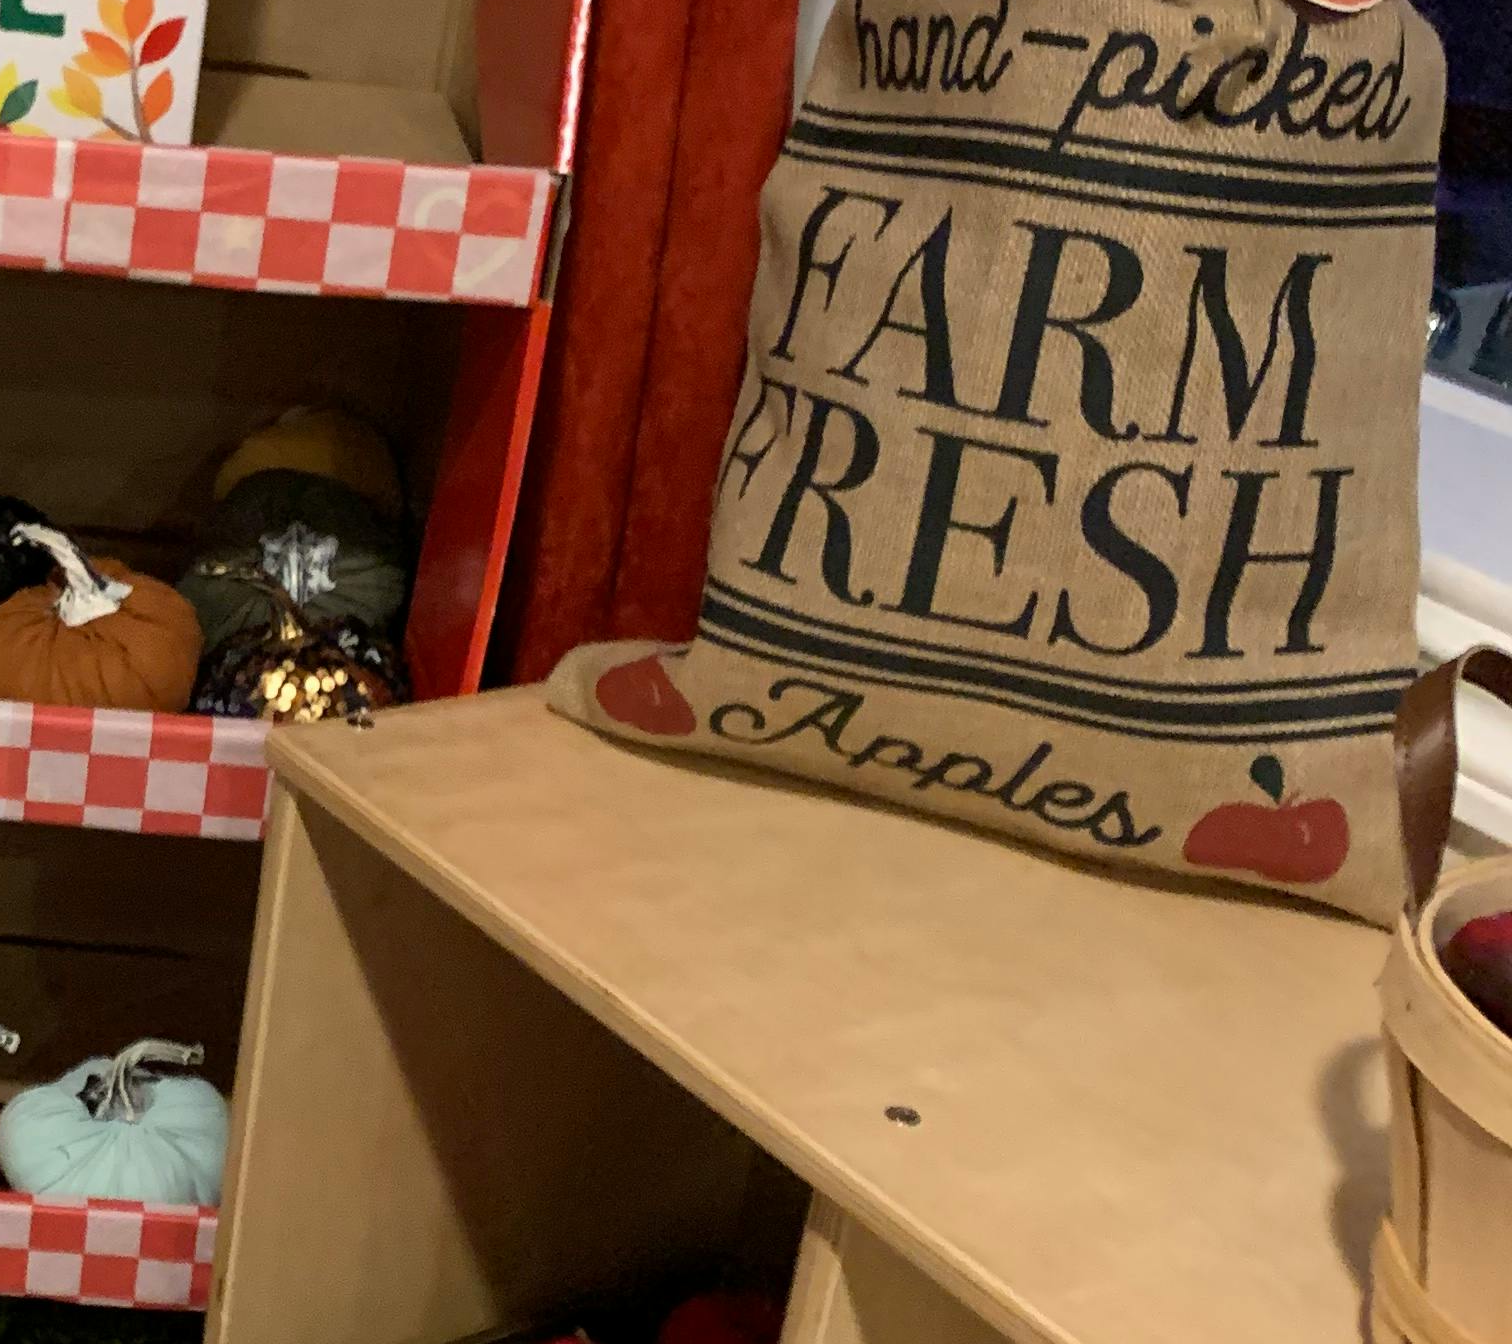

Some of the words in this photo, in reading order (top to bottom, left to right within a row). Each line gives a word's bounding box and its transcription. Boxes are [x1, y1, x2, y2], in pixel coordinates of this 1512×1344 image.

[769, 186, 1332, 448] FARM
[717, 376, 1354, 659] FRESH
[709, 678, 1163, 847] Apples
